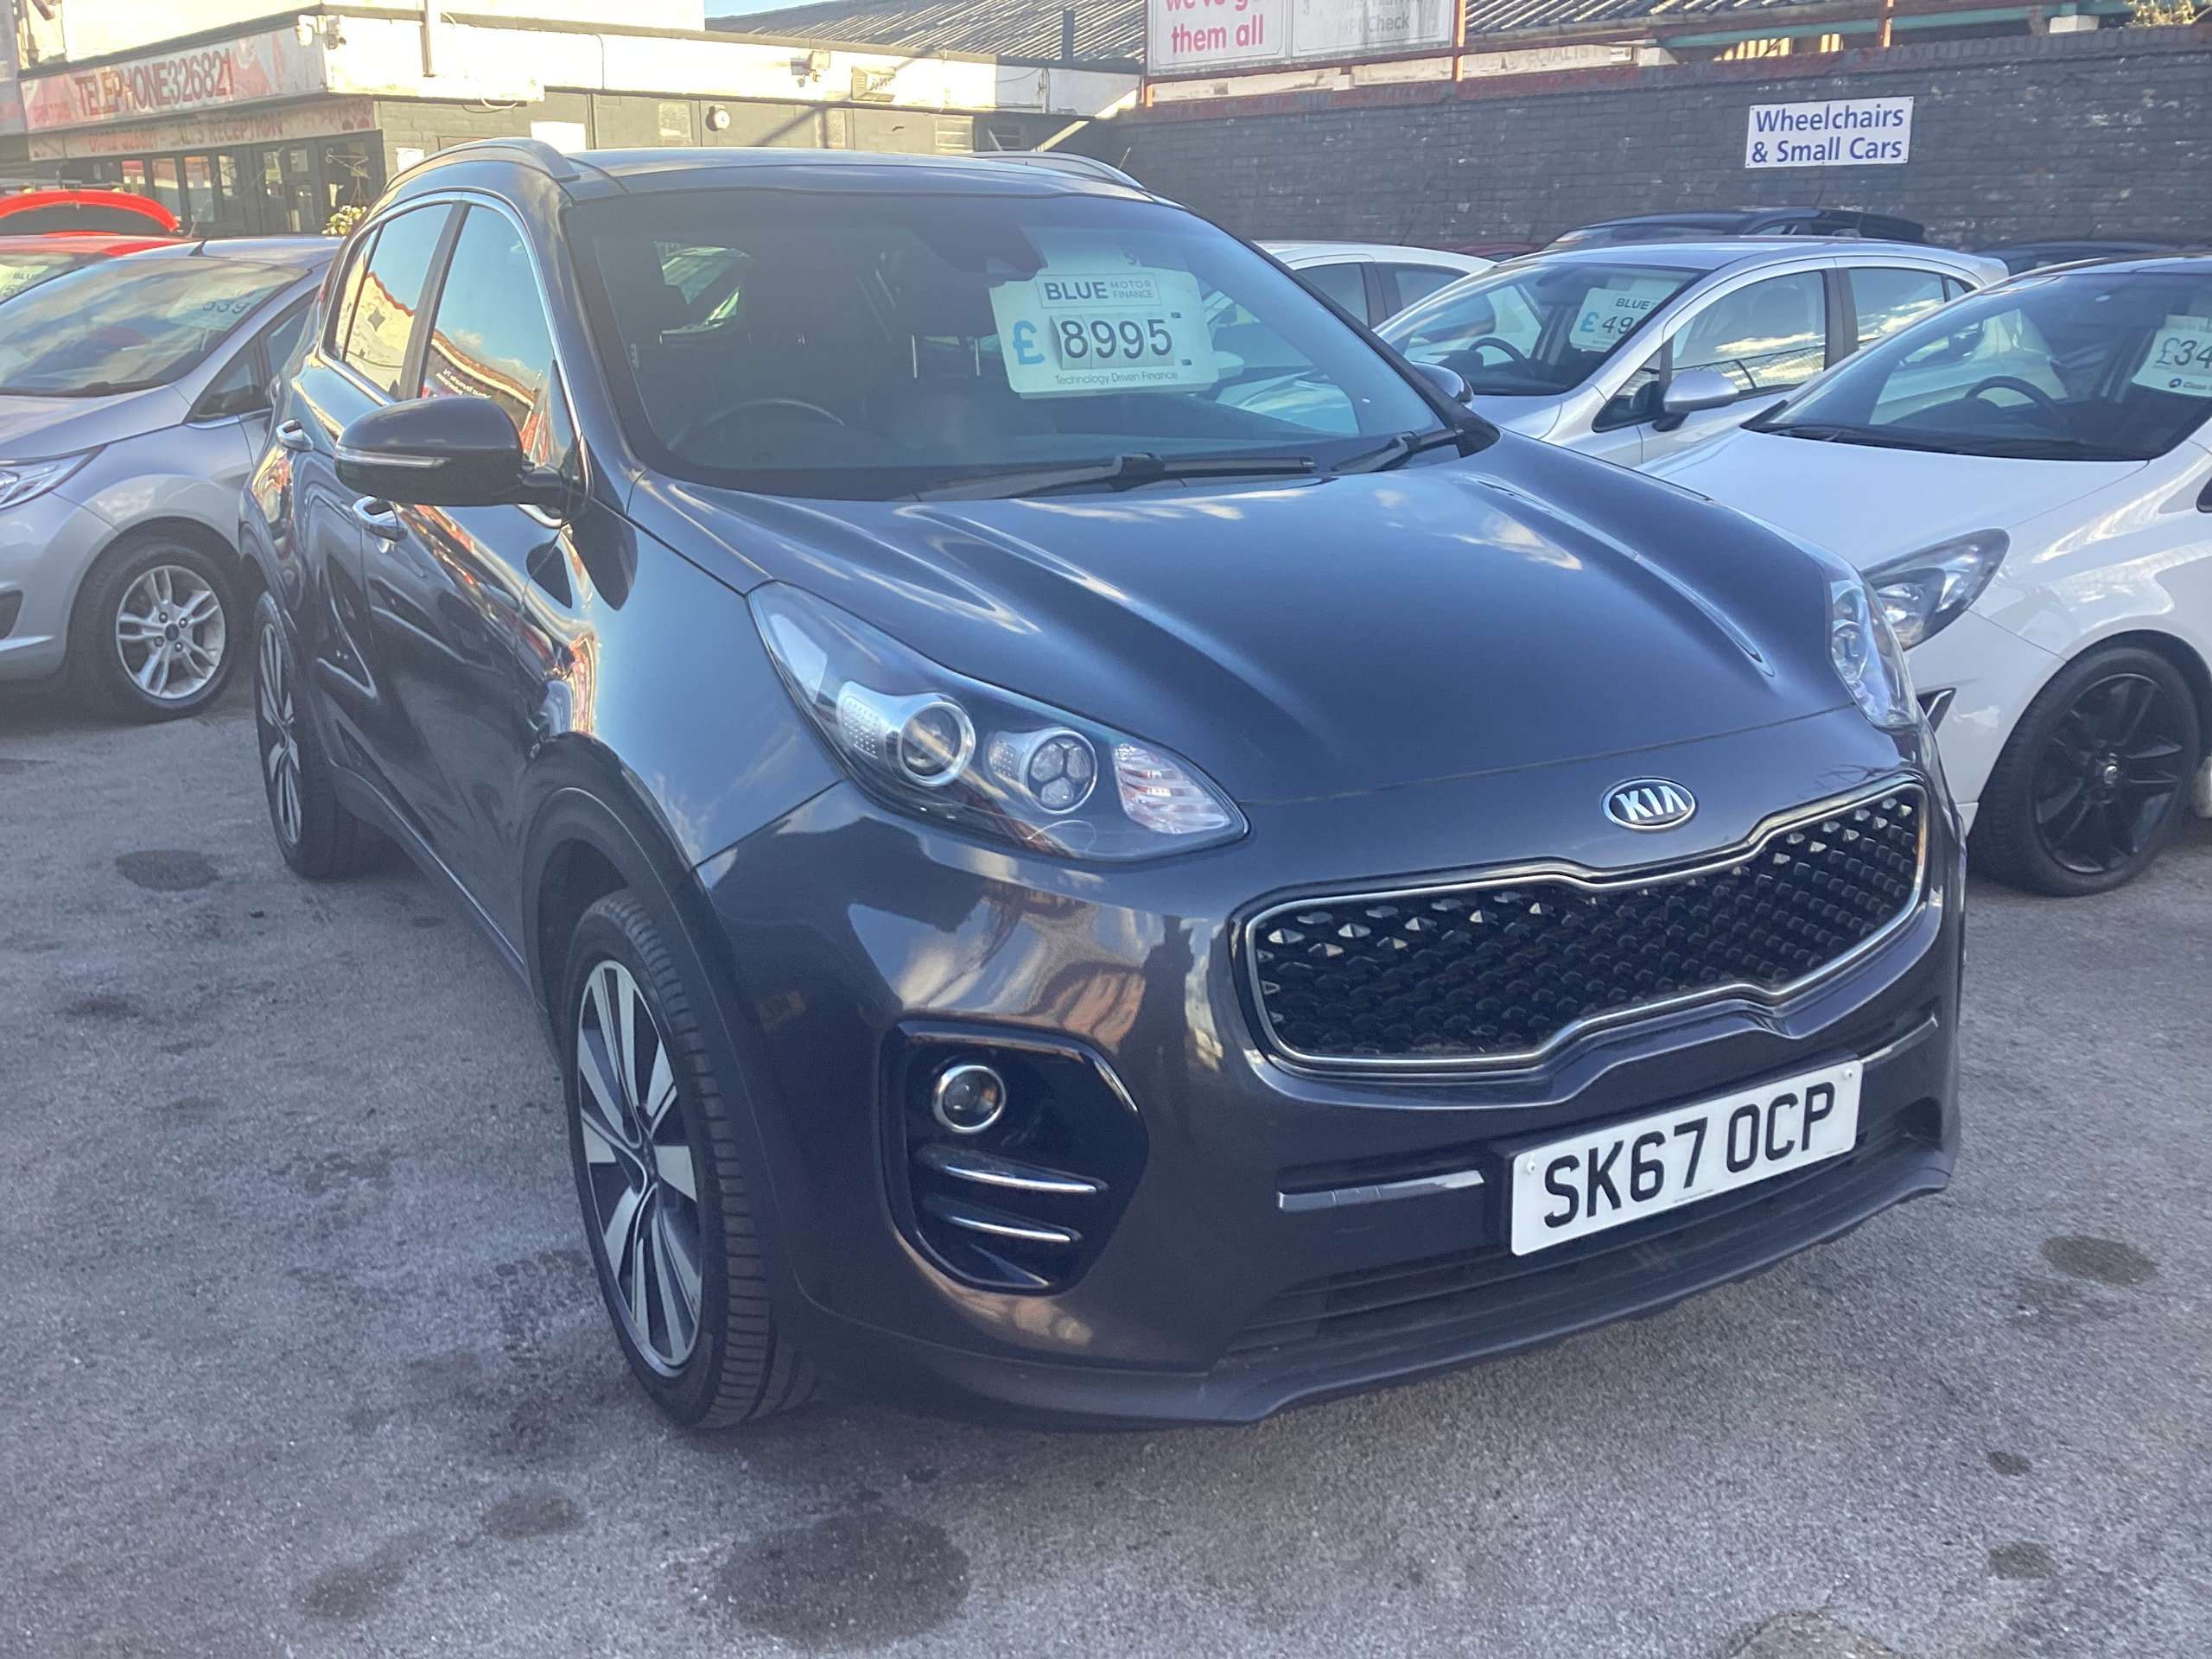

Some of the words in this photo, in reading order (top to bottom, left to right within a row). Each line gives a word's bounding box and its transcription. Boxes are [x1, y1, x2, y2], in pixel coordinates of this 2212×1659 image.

[1171, 23, 1227, 54] them
[1236, 14, 1263, 47] all
[1368, 12, 1410, 33] Check
[1756, 103, 1904, 132] Wheelchairs
[1751, 141, 1768, 163] &
[1777, 137, 1840, 162] Small
[1849, 137, 1902, 160] Cars
[1044, 282, 1109, 301] BLUE
[1110, 280, 1152, 289] MOTOR
[1114, 289, 1154, 299] FINANCE
[1615, 297, 1651, 310] BLUE
[1060, 319, 1173, 359] 8995
[1056, 374, 1109, 386] Technology
[1112, 372, 1140, 382] Driven
[1141, 372, 1178, 381] Finance
[1615, 785, 1688, 821] KIA
[1544, 1116, 1708, 1229] SK67
[1726, 1081, 1836, 1173] OCP
